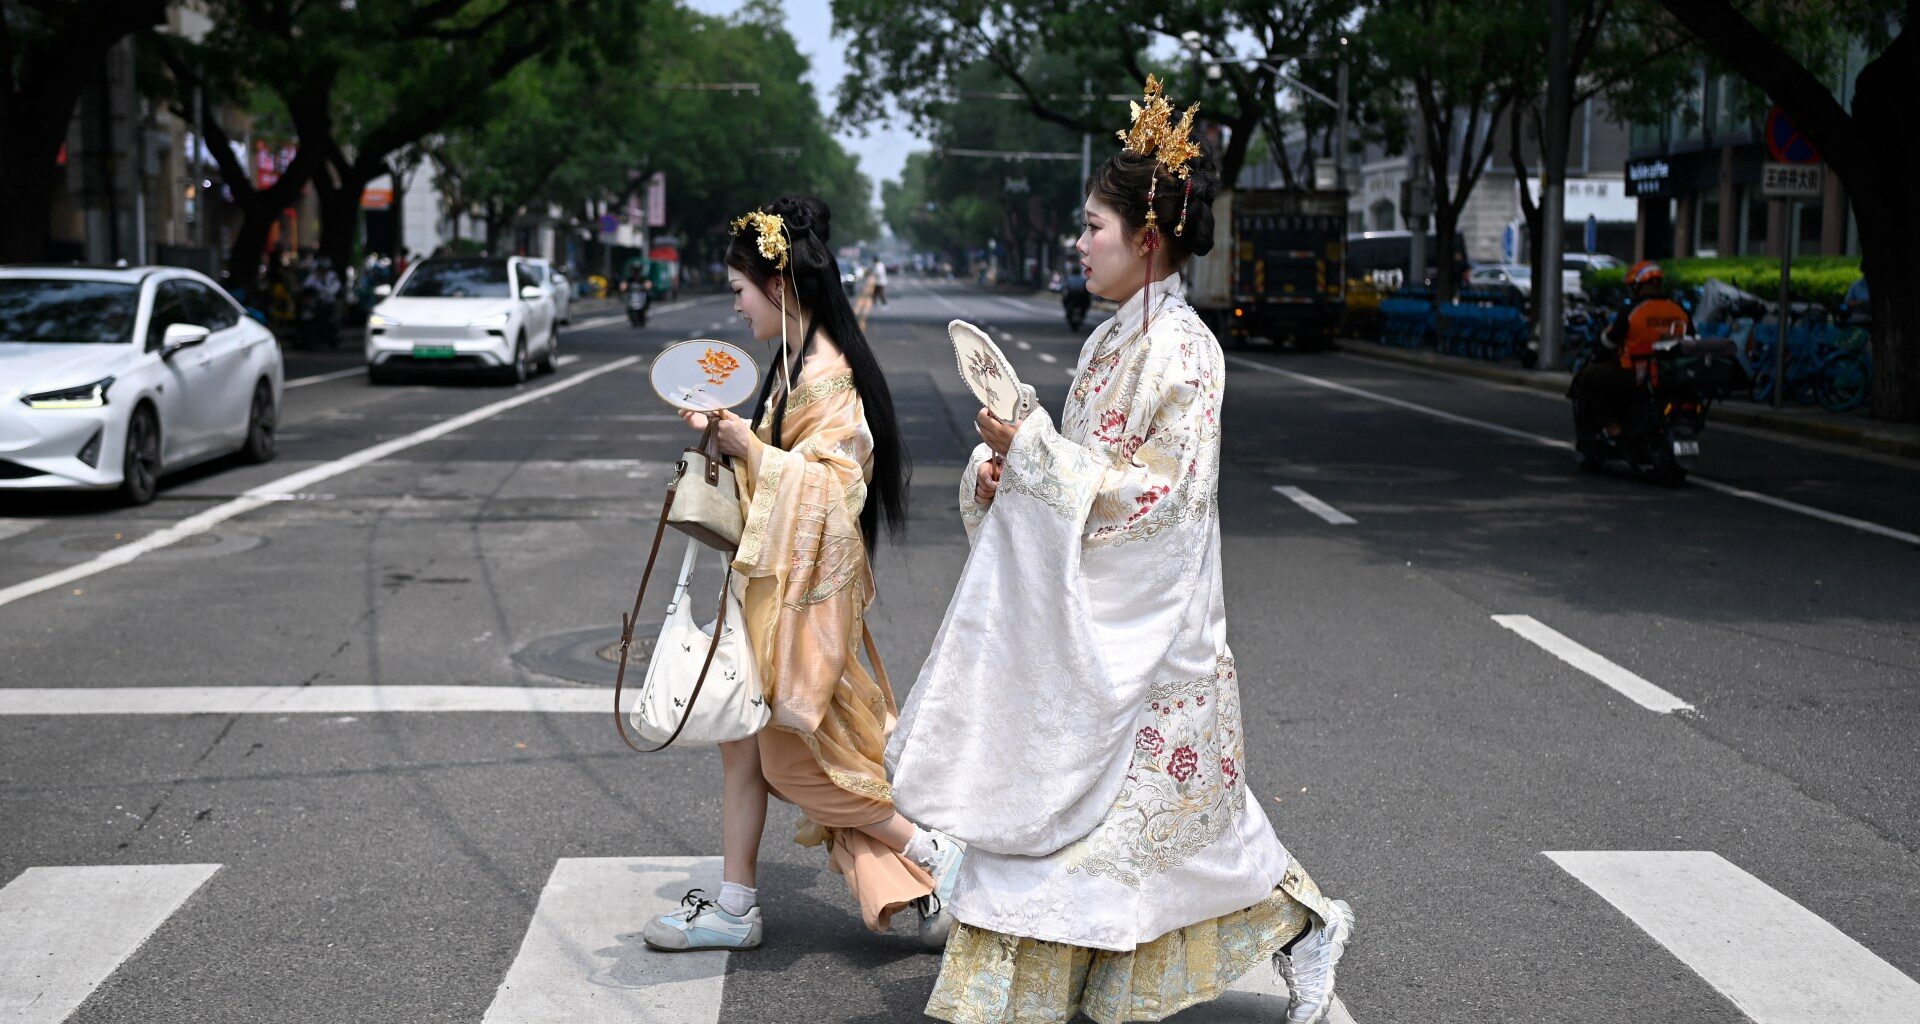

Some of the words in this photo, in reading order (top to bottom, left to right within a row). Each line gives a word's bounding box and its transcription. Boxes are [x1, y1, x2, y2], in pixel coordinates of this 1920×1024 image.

[1766, 168, 1818, 190] 王府井大街
